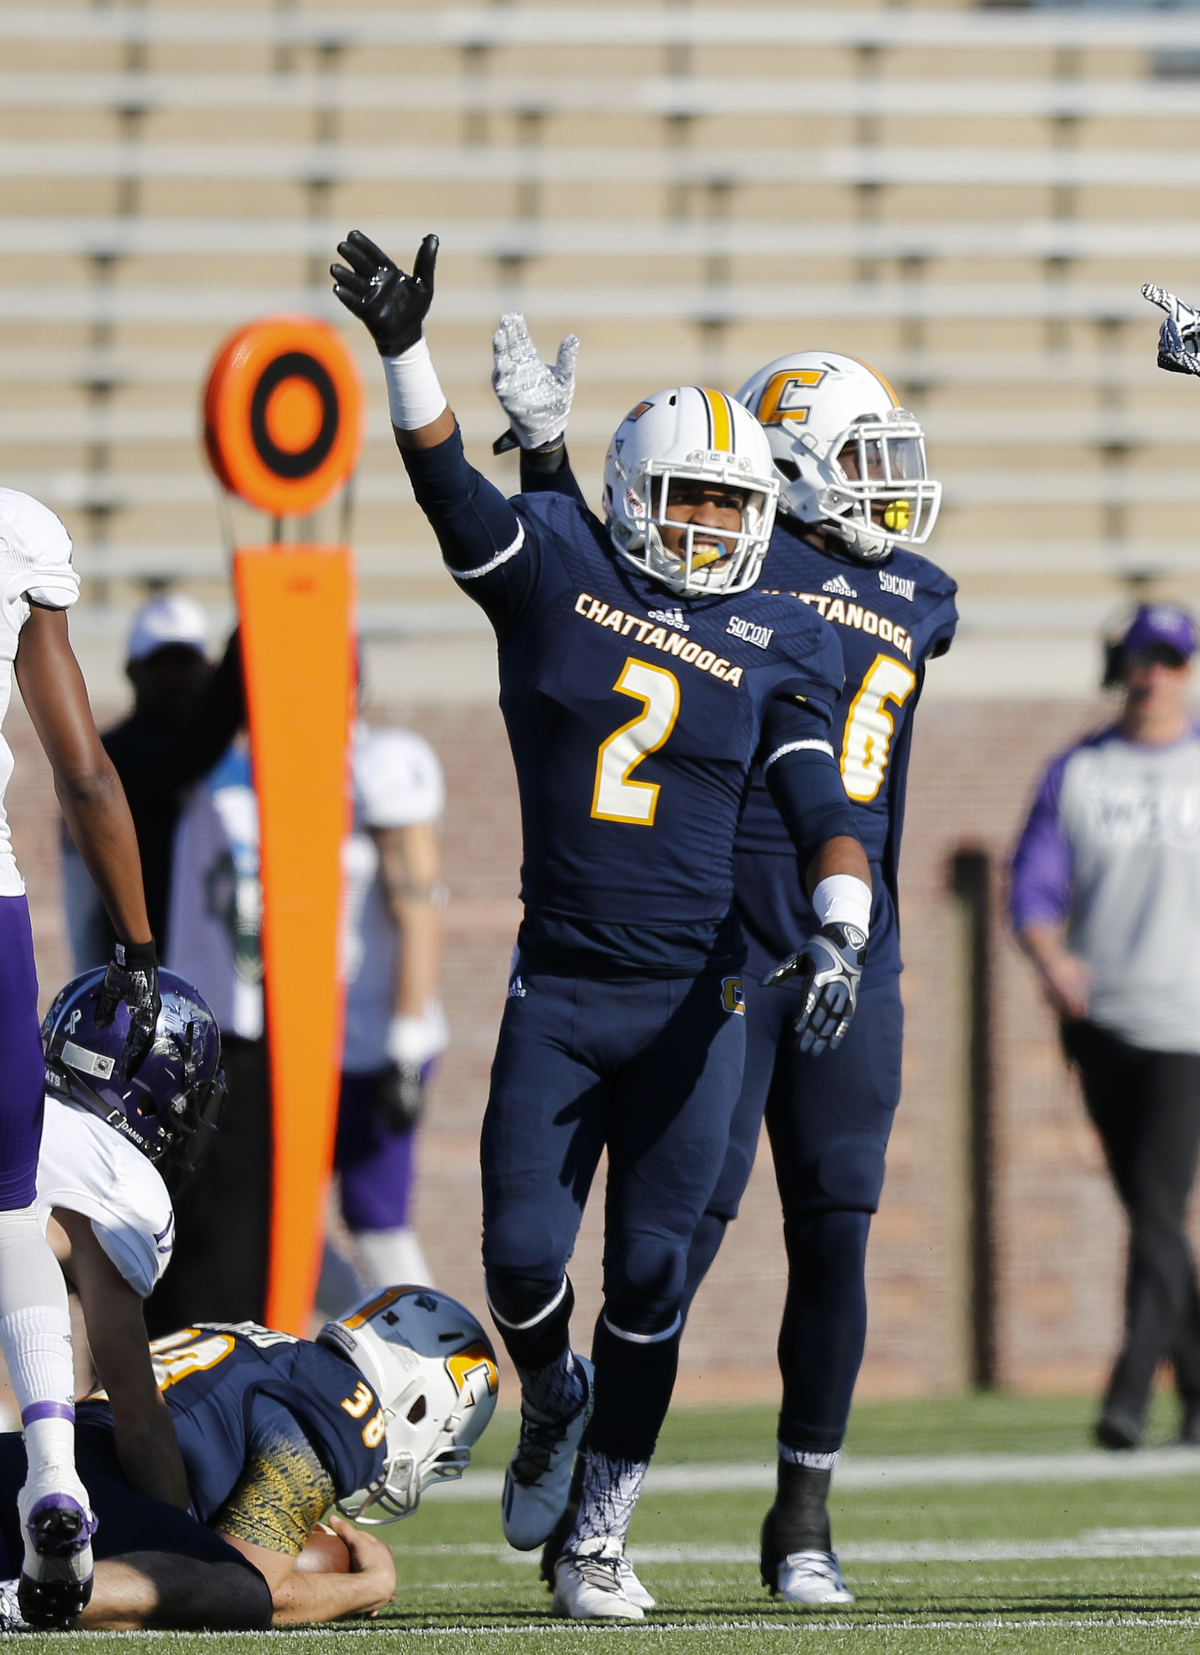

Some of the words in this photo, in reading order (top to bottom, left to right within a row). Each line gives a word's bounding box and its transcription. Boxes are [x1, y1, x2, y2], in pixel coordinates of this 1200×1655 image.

[755, 368, 828, 427] C
[879, 570, 916, 602] SOCON
[574, 592, 745, 689] CHATTANOOGA
[647, 609, 691, 633] adidas
[726, 616, 774, 650] SOCON
[591, 656, 681, 827] 2
[340, 1381, 386, 1449] 38
